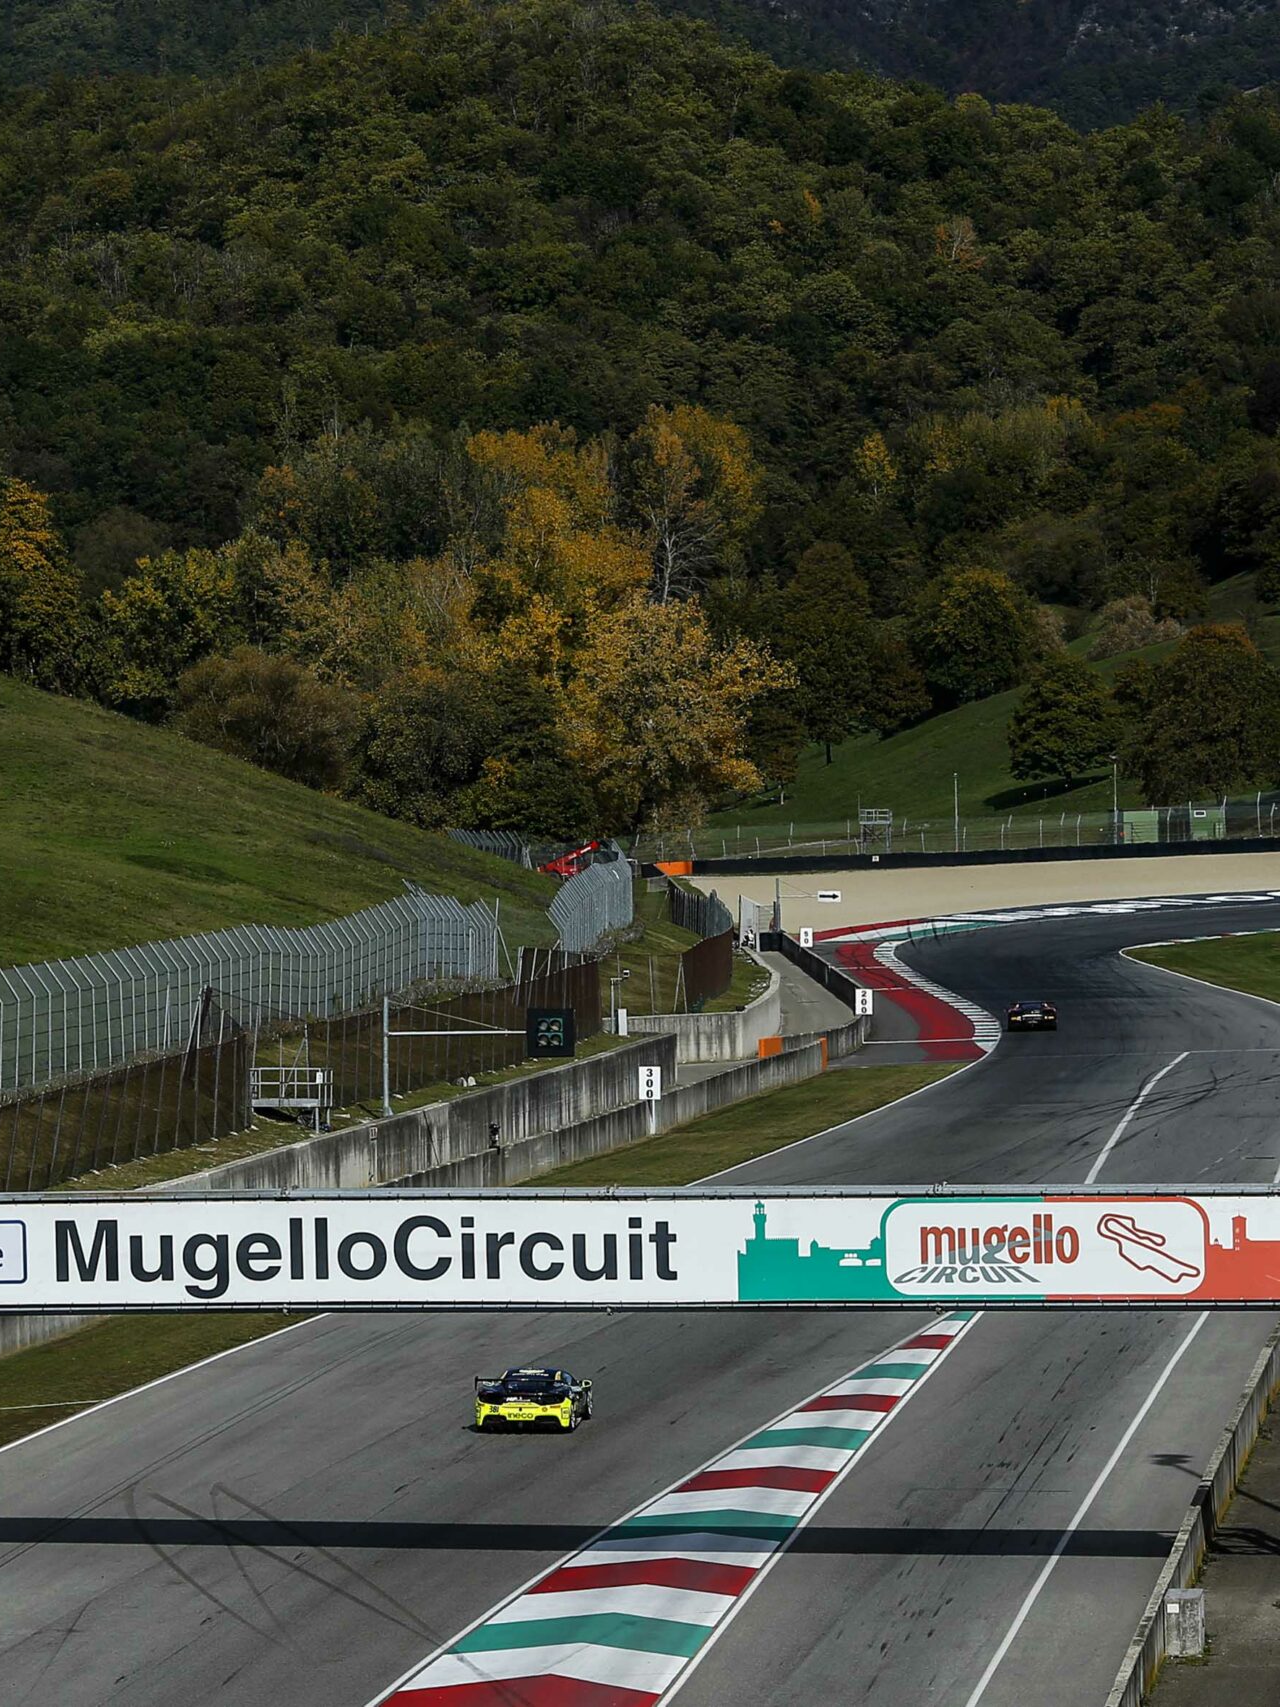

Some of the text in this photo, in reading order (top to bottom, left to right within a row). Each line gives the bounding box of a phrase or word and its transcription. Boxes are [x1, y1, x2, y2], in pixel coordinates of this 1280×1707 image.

[860, 990, 868, 1014] 200
[645, 1068, 654, 1099] 300
[919, 1213, 1080, 1266] mugello
[54, 1215, 677, 1300] MugelloCircuit
[893, 1266, 1042, 1284] CIRCUIT
